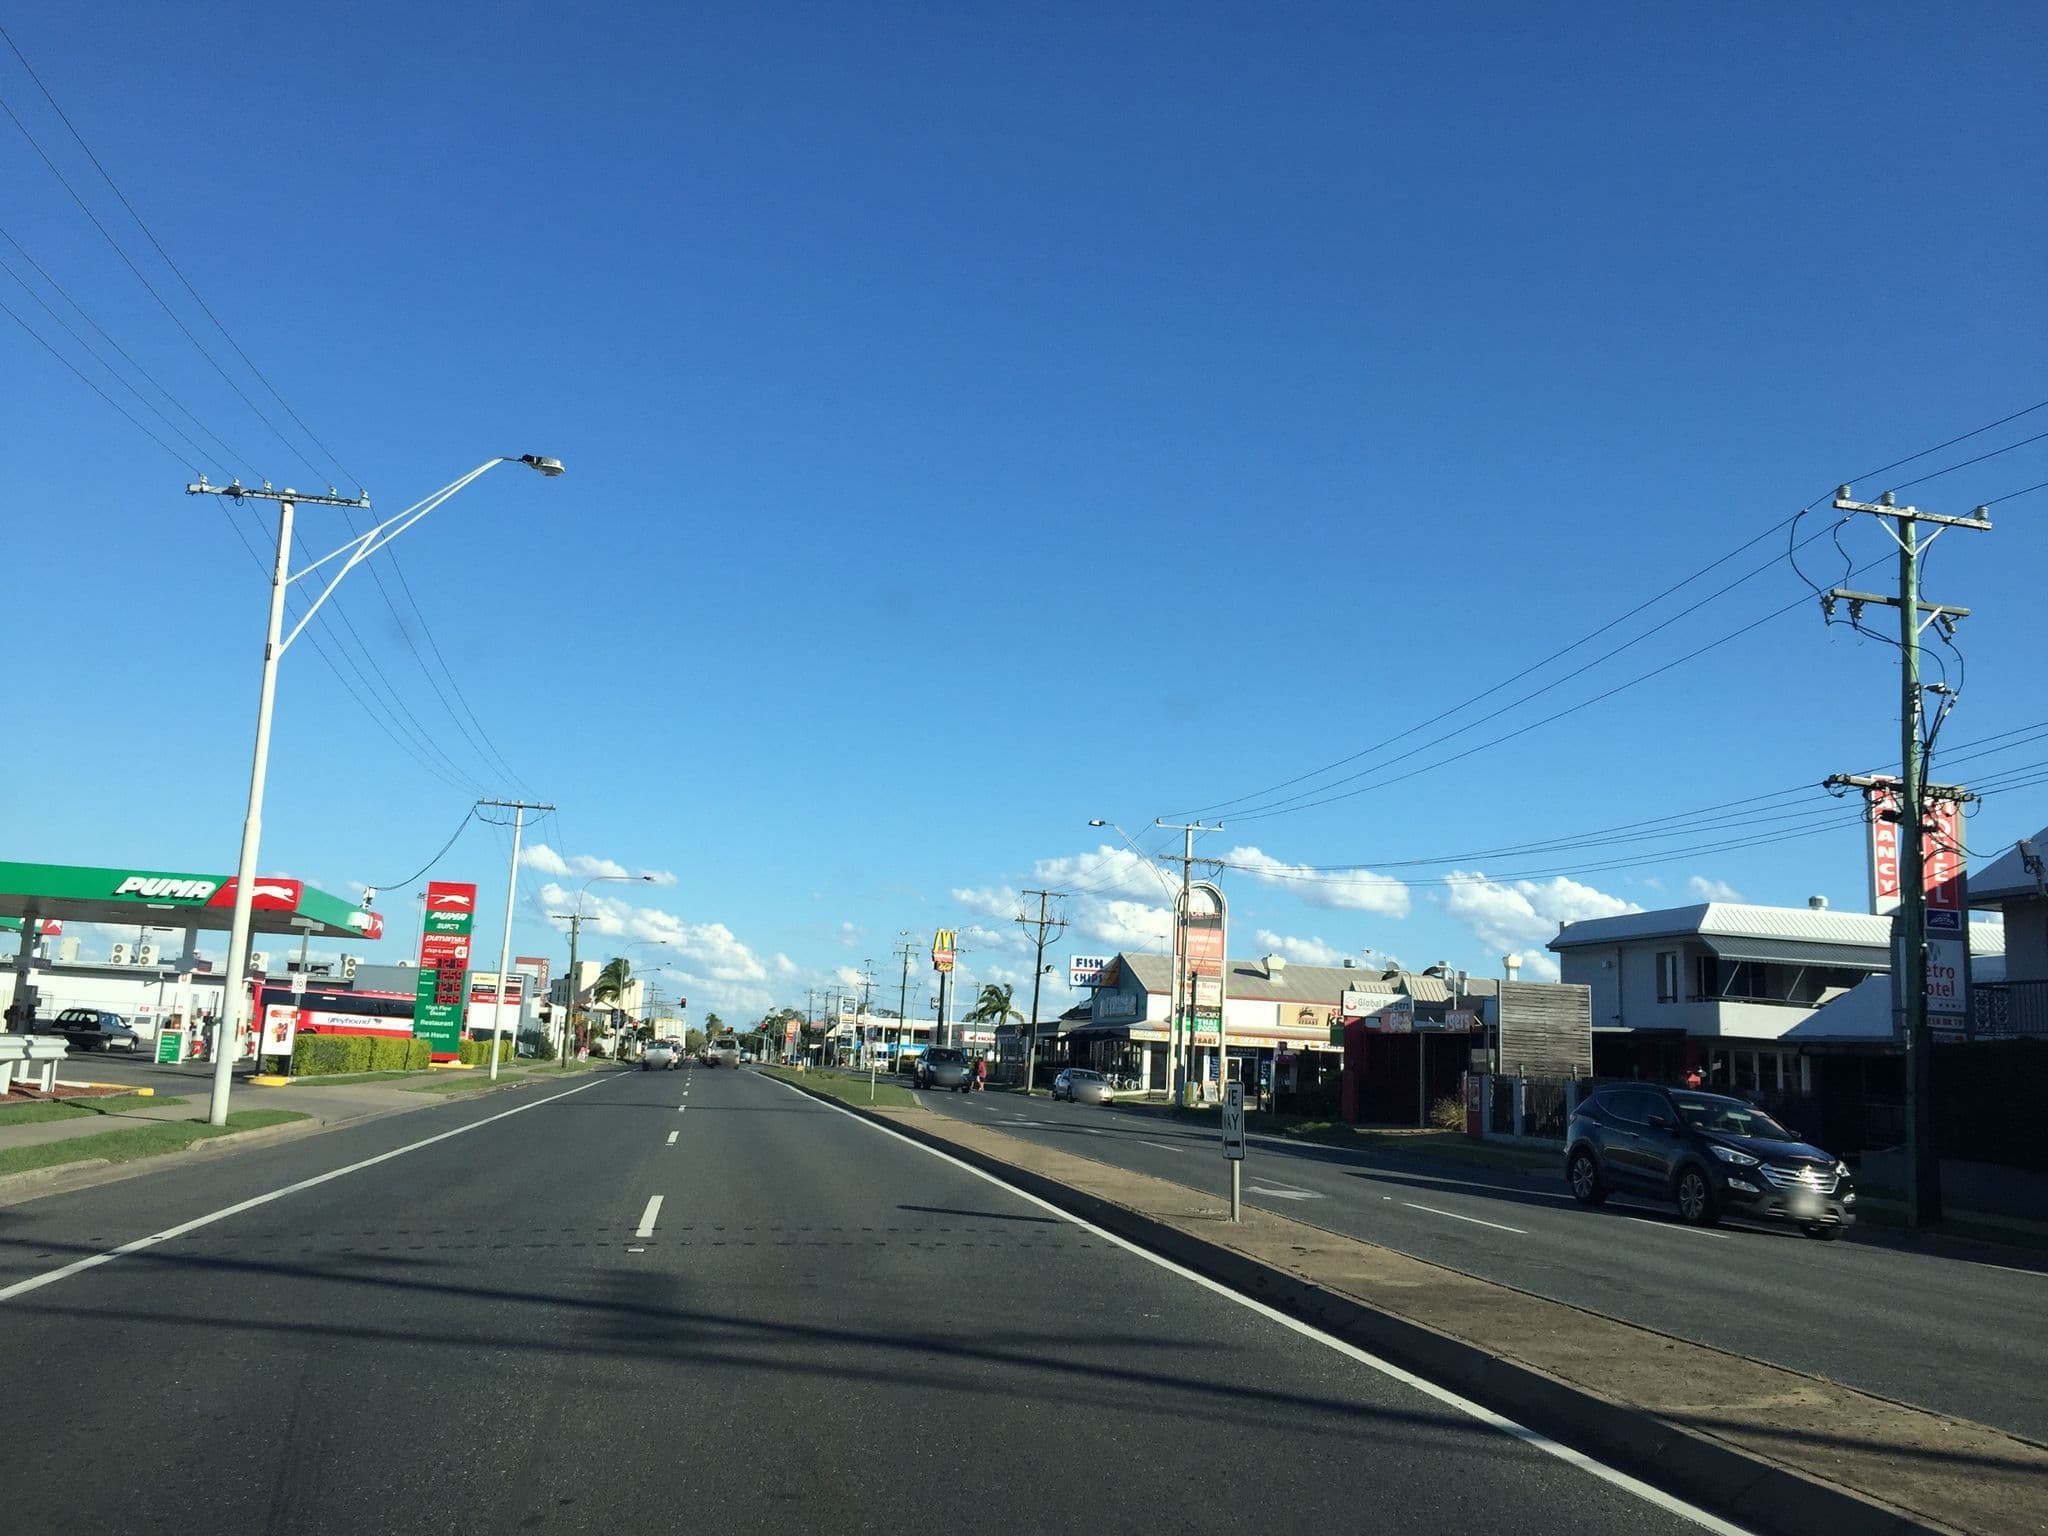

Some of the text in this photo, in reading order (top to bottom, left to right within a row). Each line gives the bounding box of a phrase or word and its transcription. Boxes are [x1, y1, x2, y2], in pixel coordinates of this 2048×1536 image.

[114, 876, 217, 900] PUMA
[430, 911, 469, 921] PUMA
[1076, 958, 1104, 969] FISH
[1926, 964, 1955, 979] etro
[1074, 973, 1104, 983] CHIPS
[1927, 981, 1955, 997] otel
[1358, 998, 1382, 1008] Global
[327, 1016, 371, 1025] greyhound
[419, 1019, 454, 1027] Restaurant
